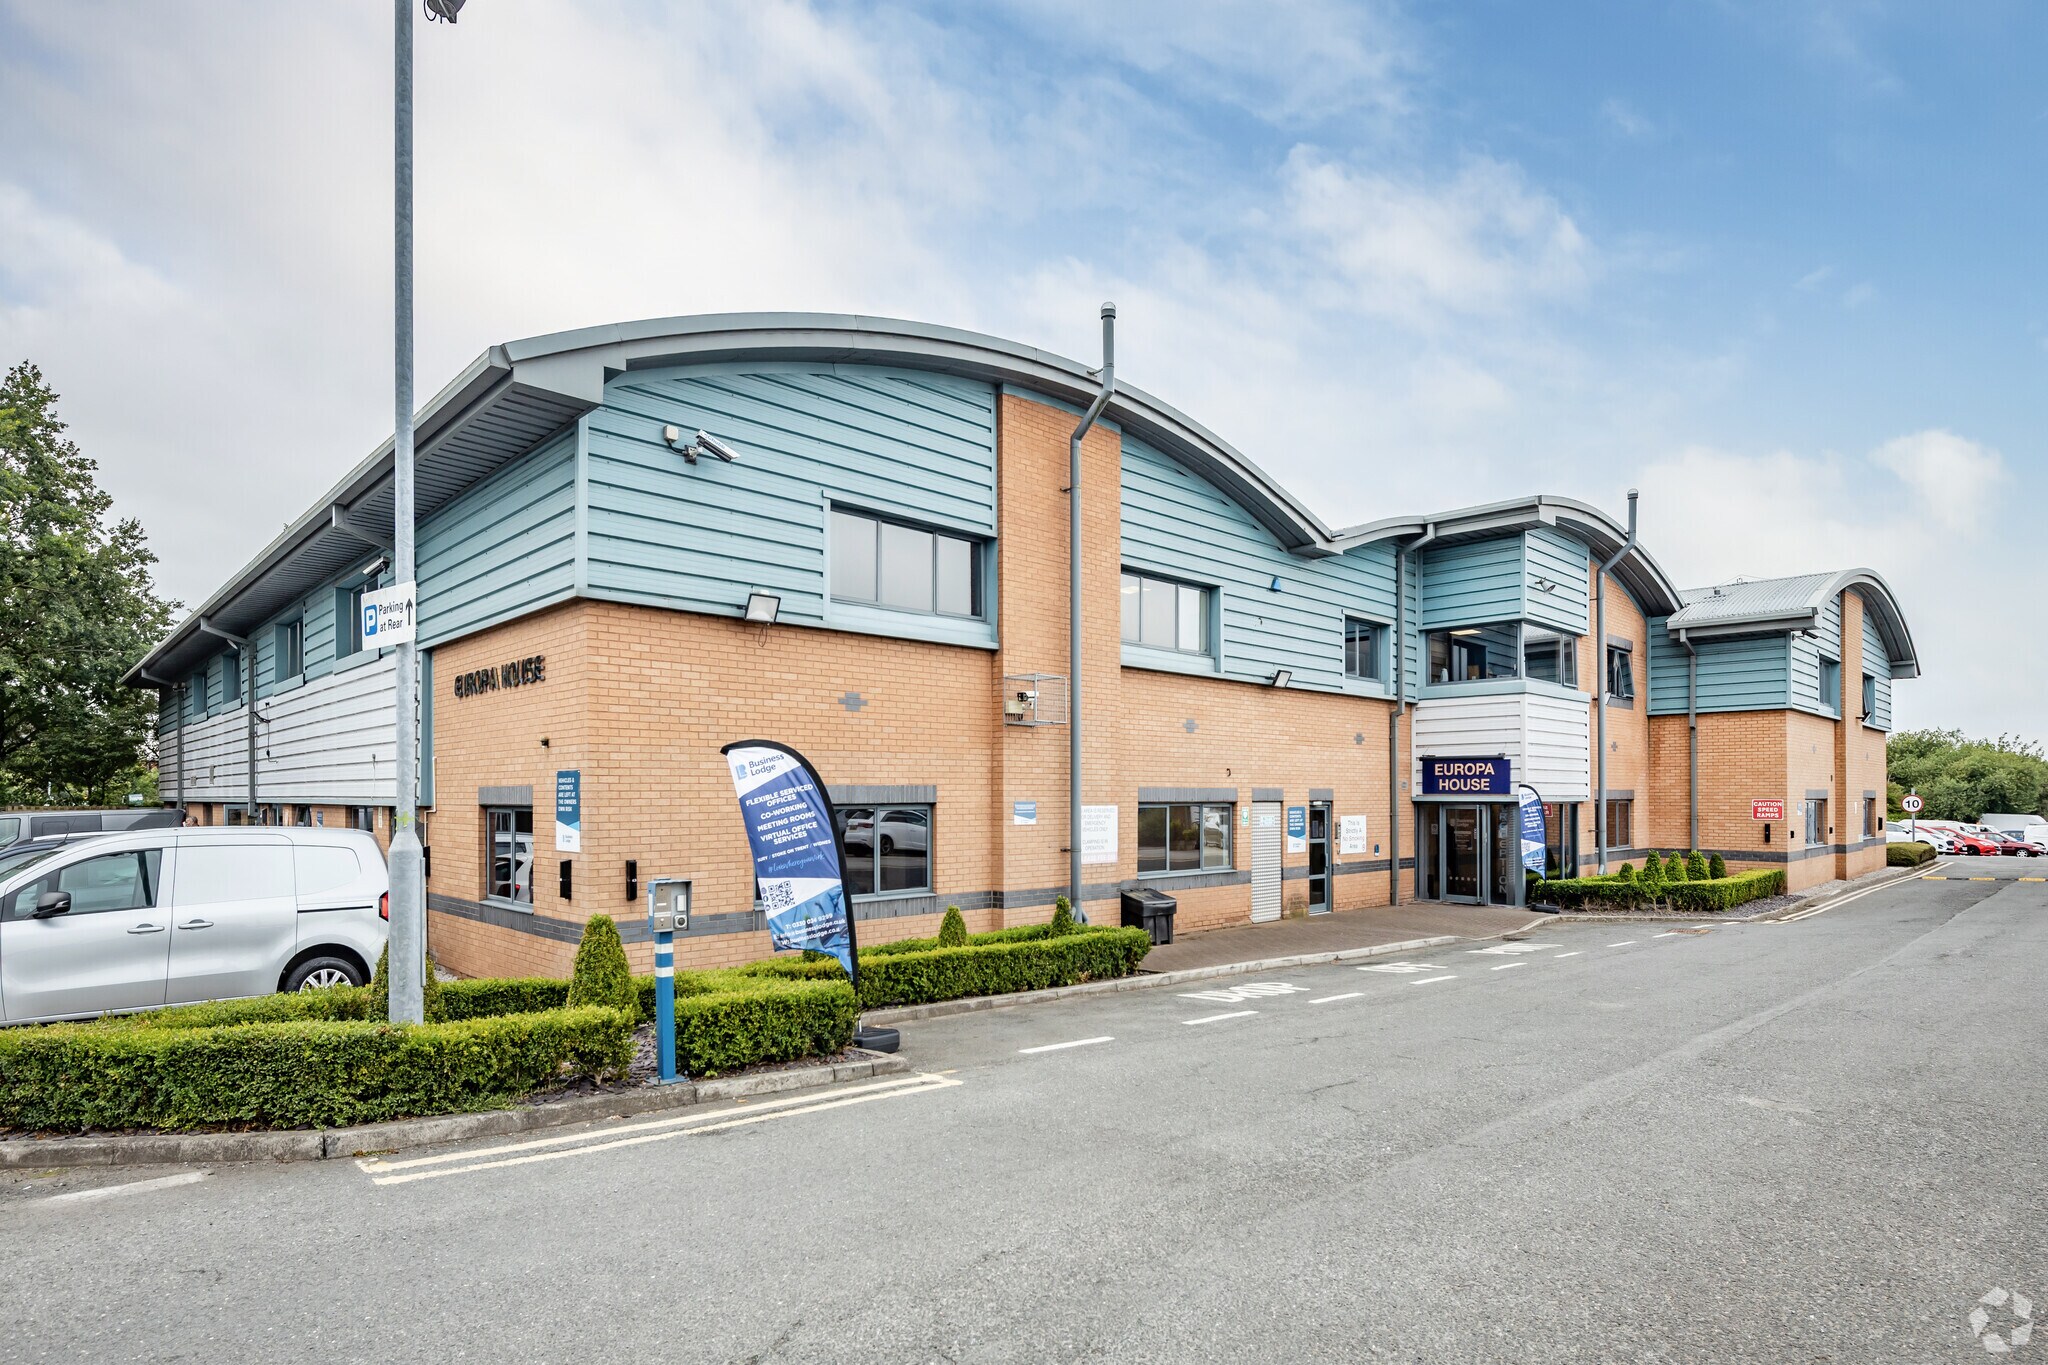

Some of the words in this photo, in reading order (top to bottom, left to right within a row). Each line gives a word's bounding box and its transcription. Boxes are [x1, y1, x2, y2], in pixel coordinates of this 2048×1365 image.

[379, 601, 403, 615] Parking
[380, 621, 386, 632] at
[388, 619, 403, 630] Rear
[454, 666, 500, 698] EUROPA
[501, 655, 546, 690] HOUSE
[749, 754, 784, 768] Business
[750, 763, 776, 776] Lodge
[1434, 763, 1495, 776] EUROPA
[1439, 779, 1490, 790] HOUSE
[746, 792, 778, 806] FLEXIBLE
[780, 784, 813, 796] SERVICED
[766, 794, 796, 807] OFFICES
[760, 802, 807, 820] CO-WORKING
[1906, 800, 1919, 808] 10
[757, 818, 788, 832] MEETING
[789, 811, 816, 822] ROOMS
[760, 828, 791, 842] VIRTUAL
[792, 821, 818, 833] OFFICE
[773, 831, 807, 845] SERVICES
[1176, 982, 1310, 1002] DROP
